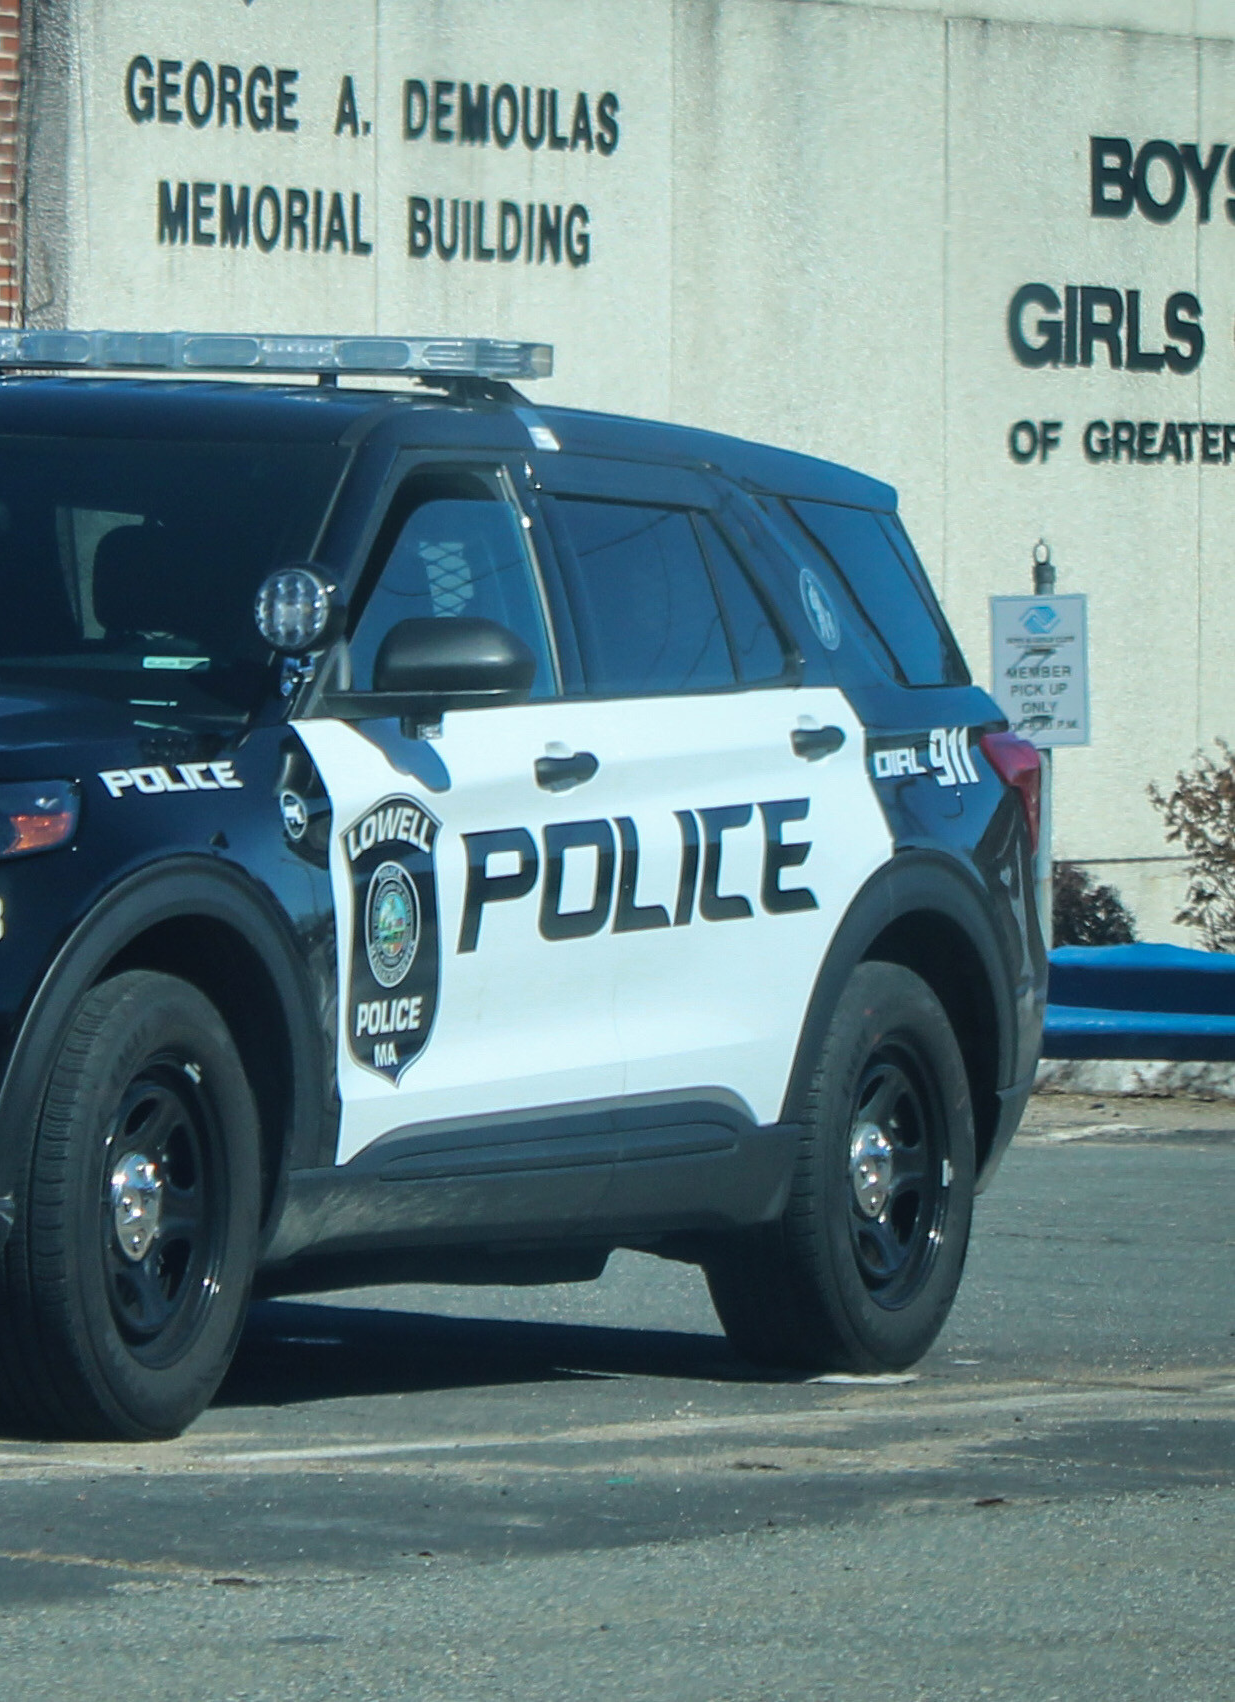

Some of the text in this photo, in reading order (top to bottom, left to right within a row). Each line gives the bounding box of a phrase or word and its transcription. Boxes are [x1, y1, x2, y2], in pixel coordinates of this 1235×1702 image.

[125, 54, 620, 156] GEORGE A. DEMOULAS
[1089, 136, 1235, 225] BOY
[157, 180, 591, 267] MEMORIAL BUILDING
[1007, 282, 1206, 376] GIRLS
[1009, 420, 1063, 464] OF
[1005, 665, 1071, 678] MEMBER
[1010, 683, 1069, 697] PICK UP
[1021, 701, 1058, 715] ONLY
[98, 761, 245, 799] POLICE
[873, 727, 980, 787] DIAL 911
[347, 806, 432, 862] LOWELL
[456, 797, 820, 954] POLICE
[356, 996, 423, 1037] POLICE
[374, 1042, 398, 1067] MA
